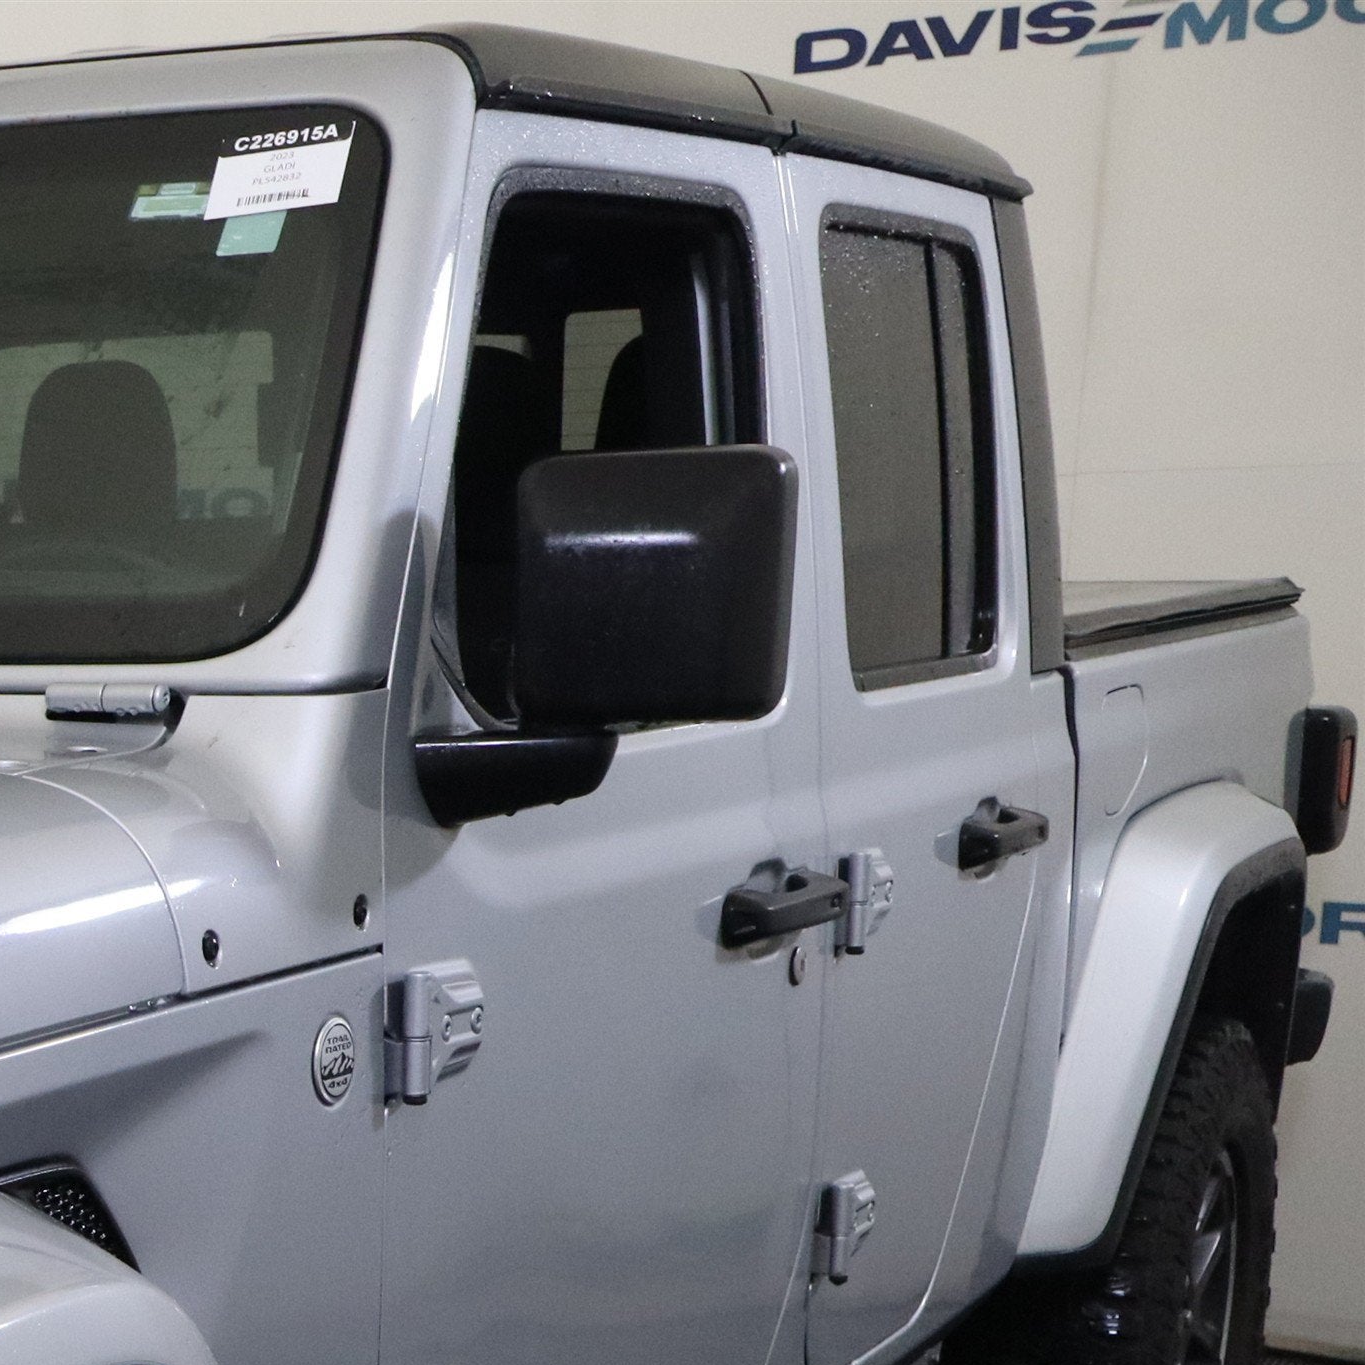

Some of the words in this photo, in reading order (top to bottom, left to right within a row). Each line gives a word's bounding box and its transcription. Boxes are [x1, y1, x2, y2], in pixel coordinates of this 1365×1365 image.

[794, 0, 1095, 74] DAVIS
[234, 123, 338, 151] C226915A
[270, 151, 295, 162] 2023
[327, 1035, 349, 1045] TRAIL
[325, 1042, 352, 1054] RATED
